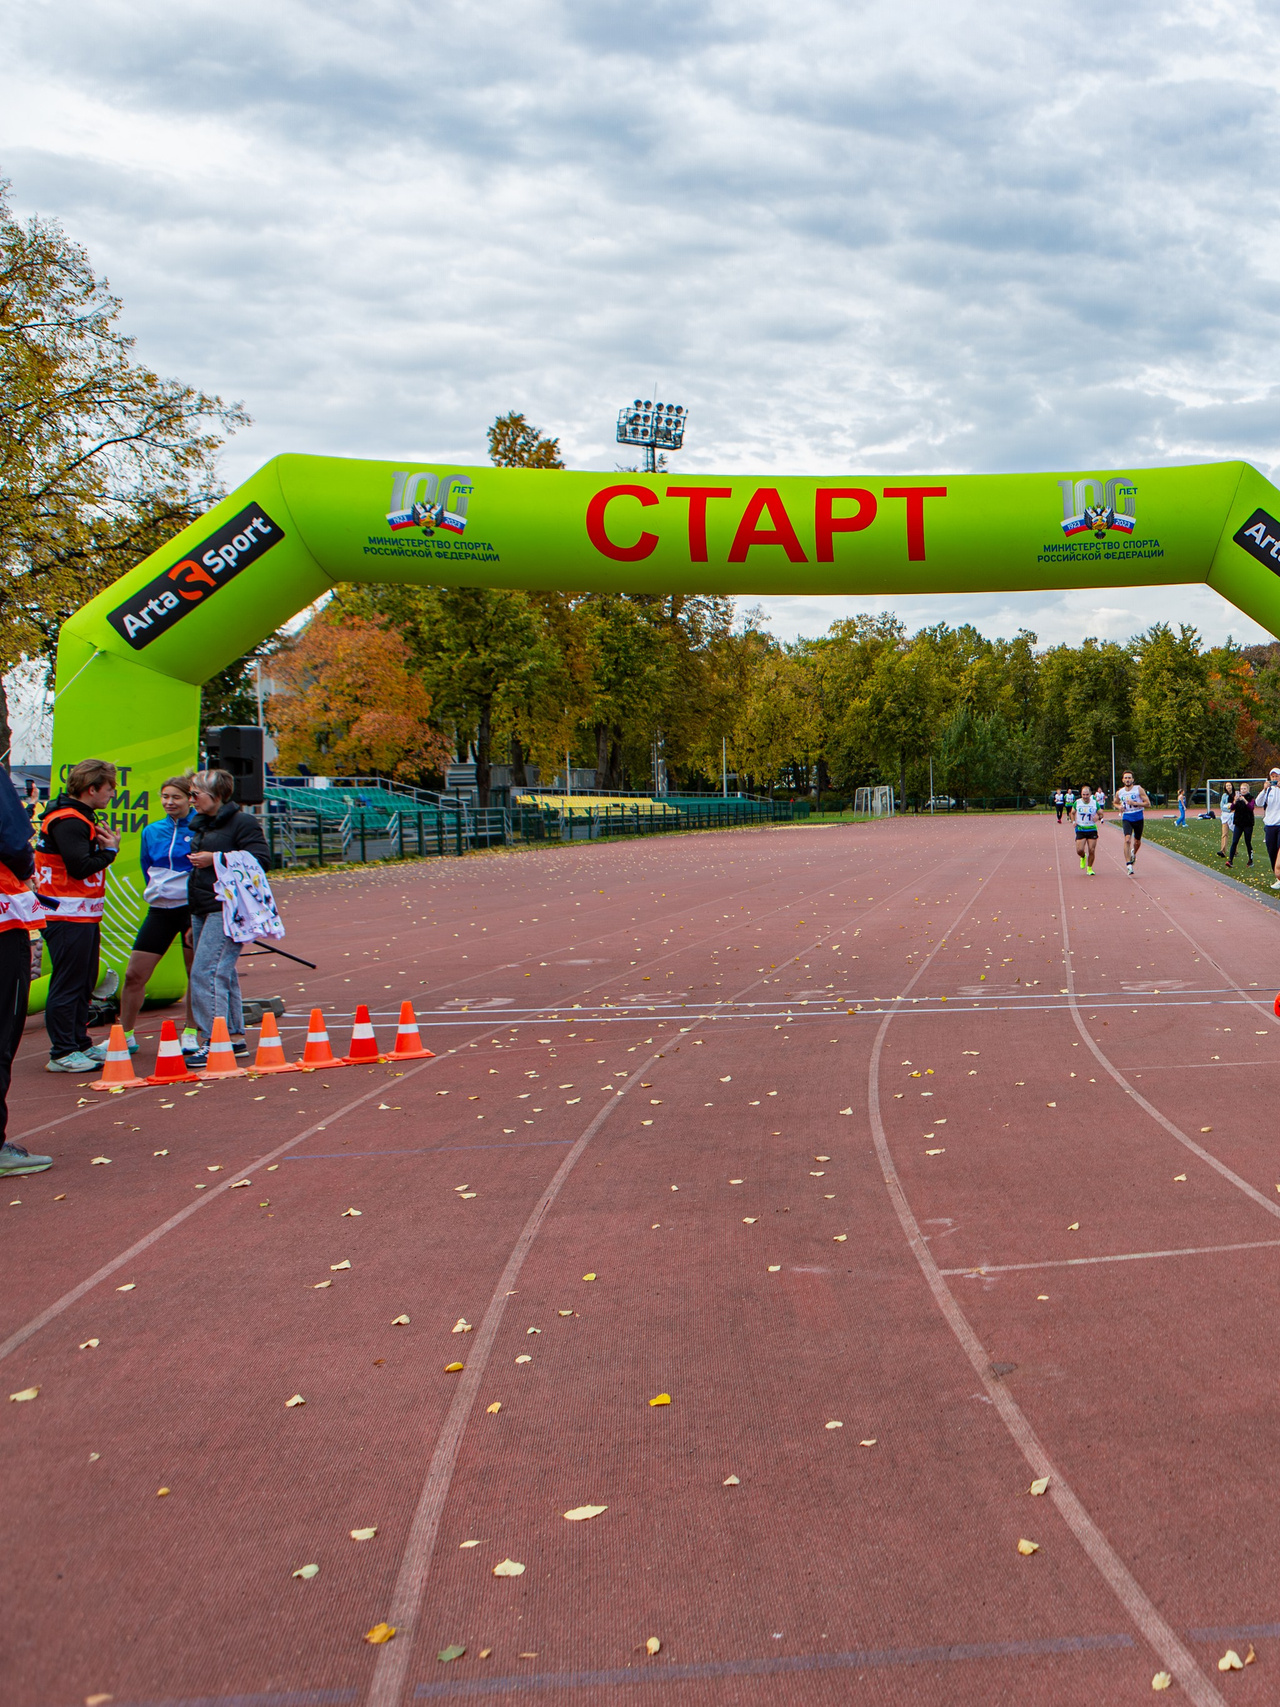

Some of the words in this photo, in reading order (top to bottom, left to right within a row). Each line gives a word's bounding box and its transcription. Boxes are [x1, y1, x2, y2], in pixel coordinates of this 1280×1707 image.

[452, 486, 475, 495] ЛЕТ
[1118, 487, 1138, 496] ЛЕТ
[444, 517, 461, 529] 2023
[586, 484, 947, 563] СТАРТ
[1067, 520, 1081, 530] 1923
[1115, 519, 1131, 529] 2023
[367, 536, 452, 550] МИНИСТЕРСТВО
[453, 540, 495, 552] СПОРТА
[1043, 541, 1121, 554] МИНИСТЕРСТВО
[1122, 539, 1161, 551] СПОРТА
[363, 546, 433, 559] РОССИЙСКОЙ
[435, 551, 501, 563] ФЕДЕРАЦИИ
[1037, 550, 1102, 563] РОССИЙСКОЙ
[1104, 548, 1165, 561] ФЕДЕРАЦИИ
[122, 590, 181, 640] Arta
[202, 516, 273, 575] Sport
[1079, 813, 1092, 822] 71
